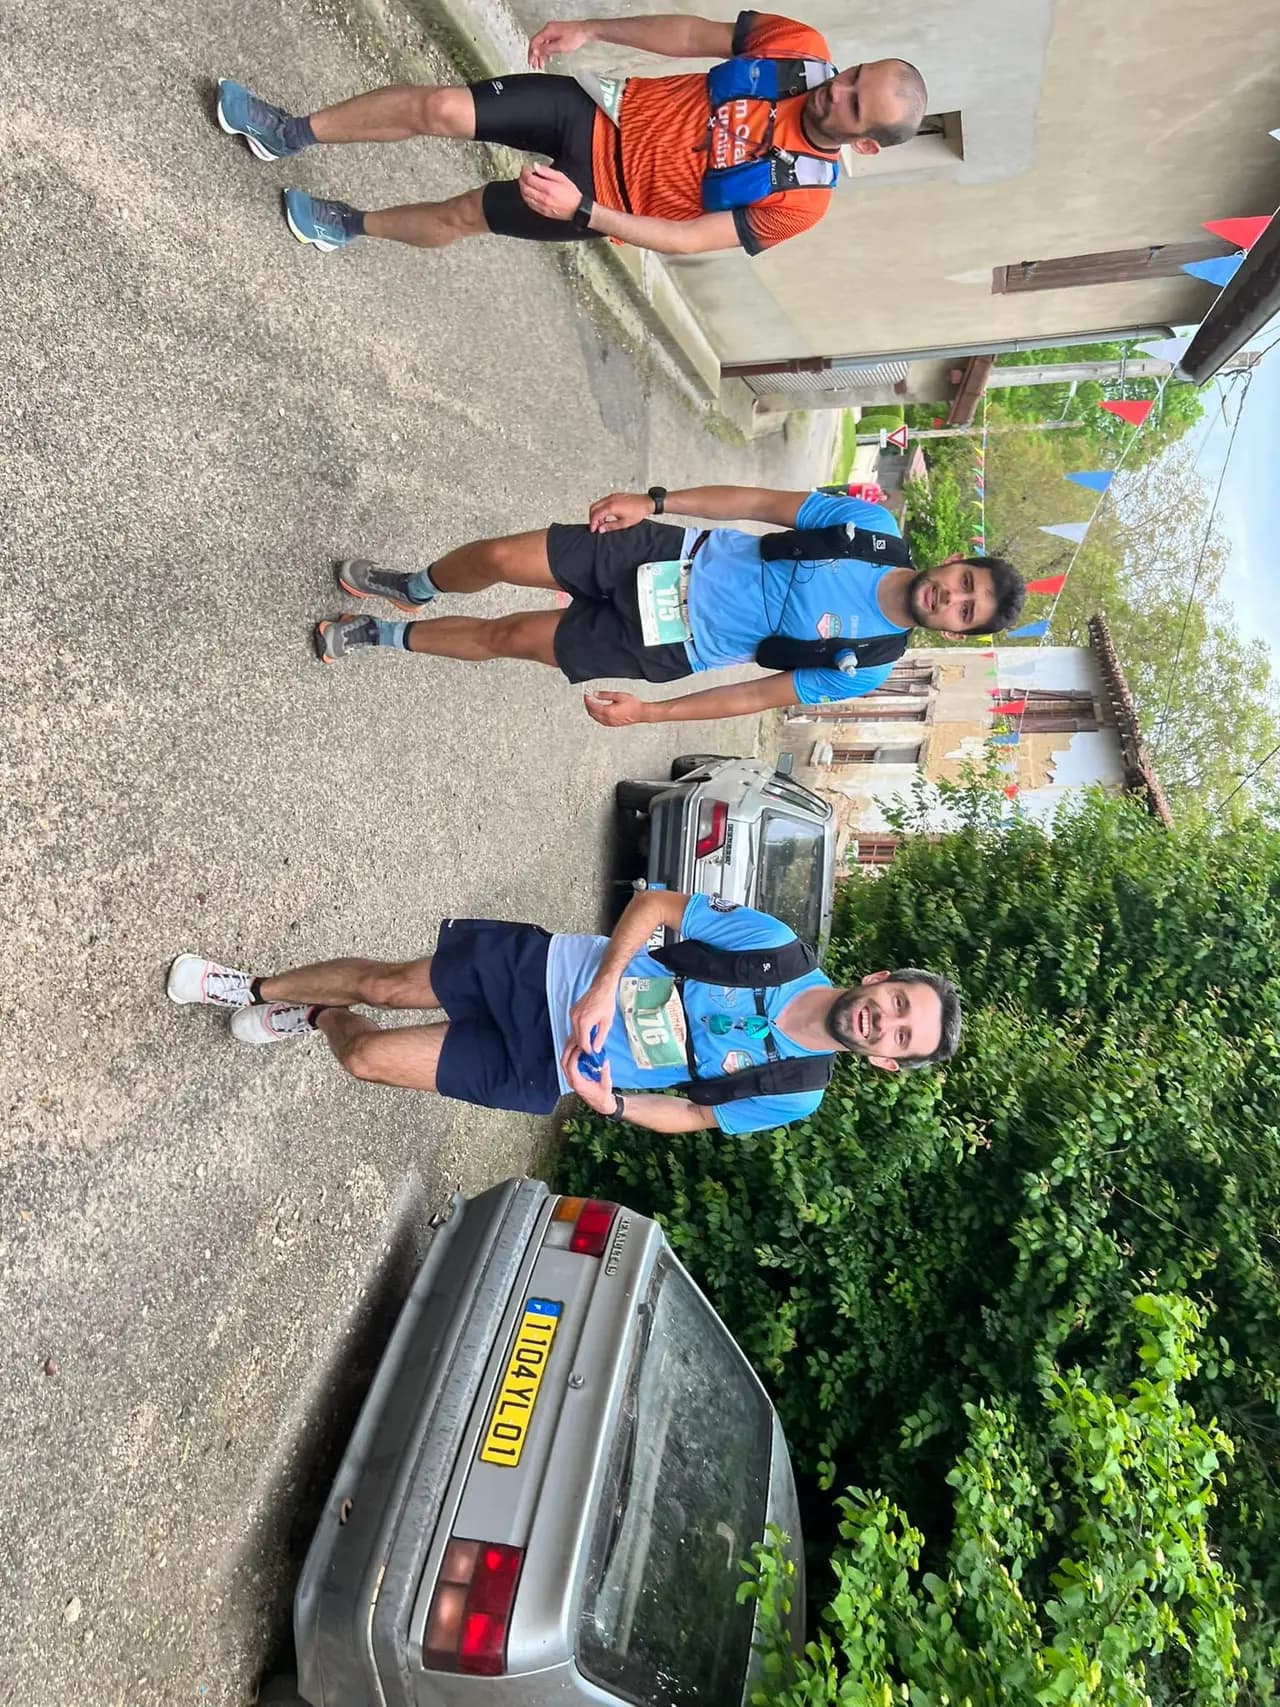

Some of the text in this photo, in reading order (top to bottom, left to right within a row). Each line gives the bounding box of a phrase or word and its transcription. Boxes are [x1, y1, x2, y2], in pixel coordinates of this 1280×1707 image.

[714, 106, 730, 169] unning
[655, 584, 680, 621] 175
[637, 1009, 669, 1045] 176
[605, 1216, 631, 1275] RENAULT 19
[488, 1323, 552, 1456] 1104 YL 01
